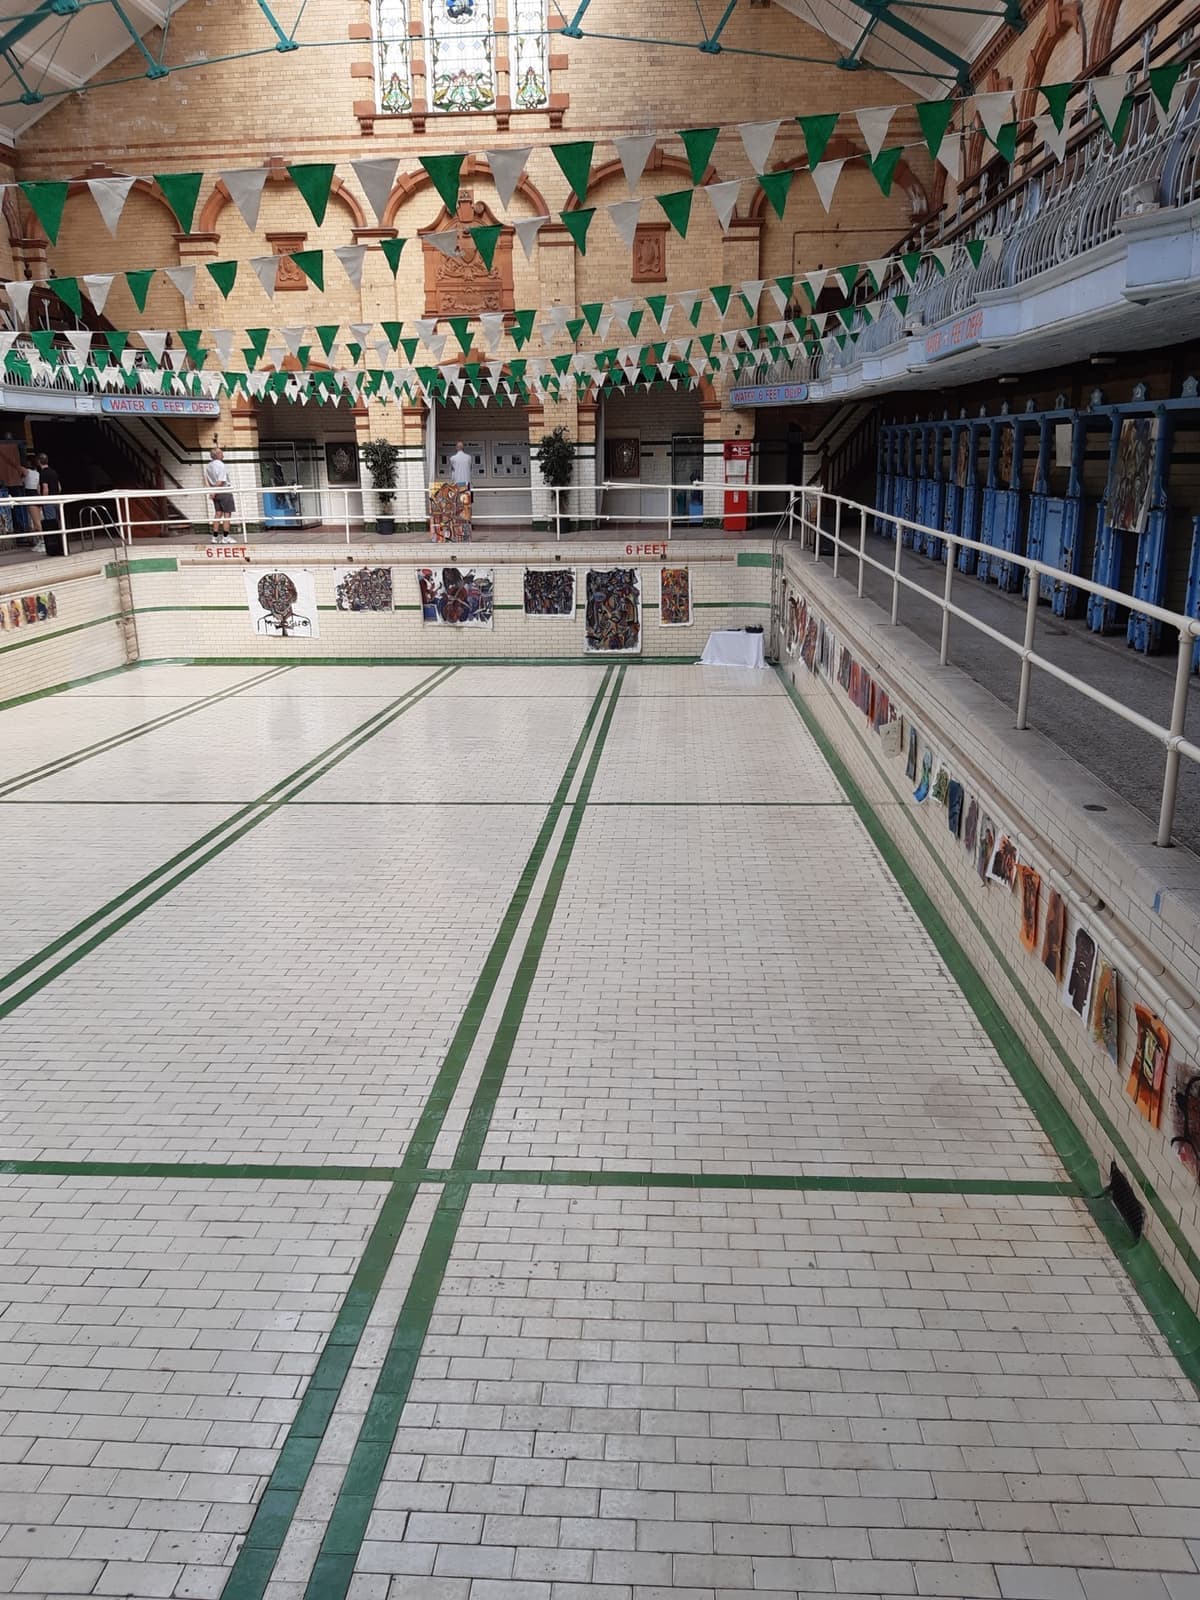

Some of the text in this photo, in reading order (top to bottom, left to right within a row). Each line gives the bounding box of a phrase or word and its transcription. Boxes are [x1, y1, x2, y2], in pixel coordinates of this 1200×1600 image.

[109, 399, 215, 412] WATER 6 FEET DEEP
[206, 547, 247, 558] 6 FEET
[626, 544, 668, 555] 6 FEET
